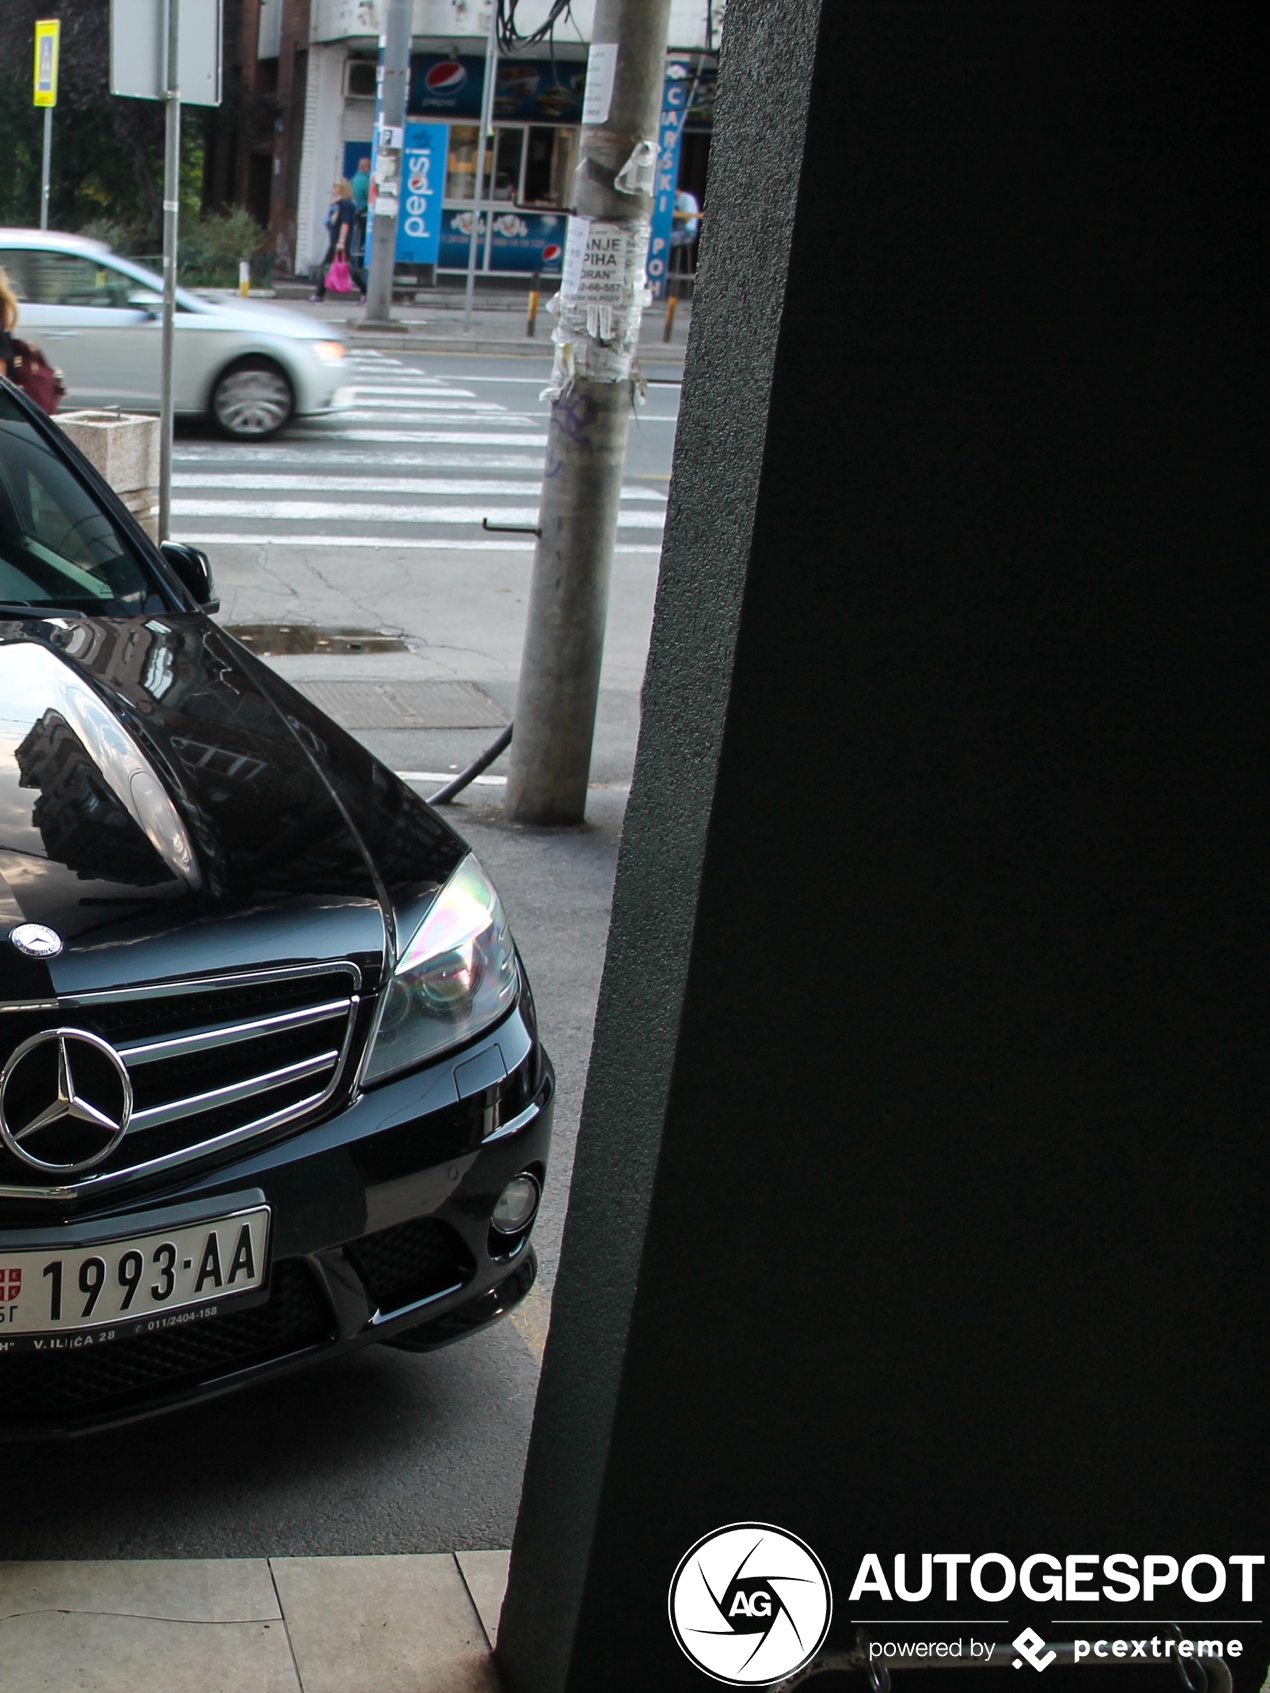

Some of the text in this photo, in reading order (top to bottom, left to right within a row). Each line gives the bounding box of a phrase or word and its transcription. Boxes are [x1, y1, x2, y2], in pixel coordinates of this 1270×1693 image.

[404, 148, 433, 238] pepsi
[659, 87, 681, 213] CARSKI
[99, 1330, 116, 1342] 28
[147, 1306, 218, 1330] 011/2404-158
